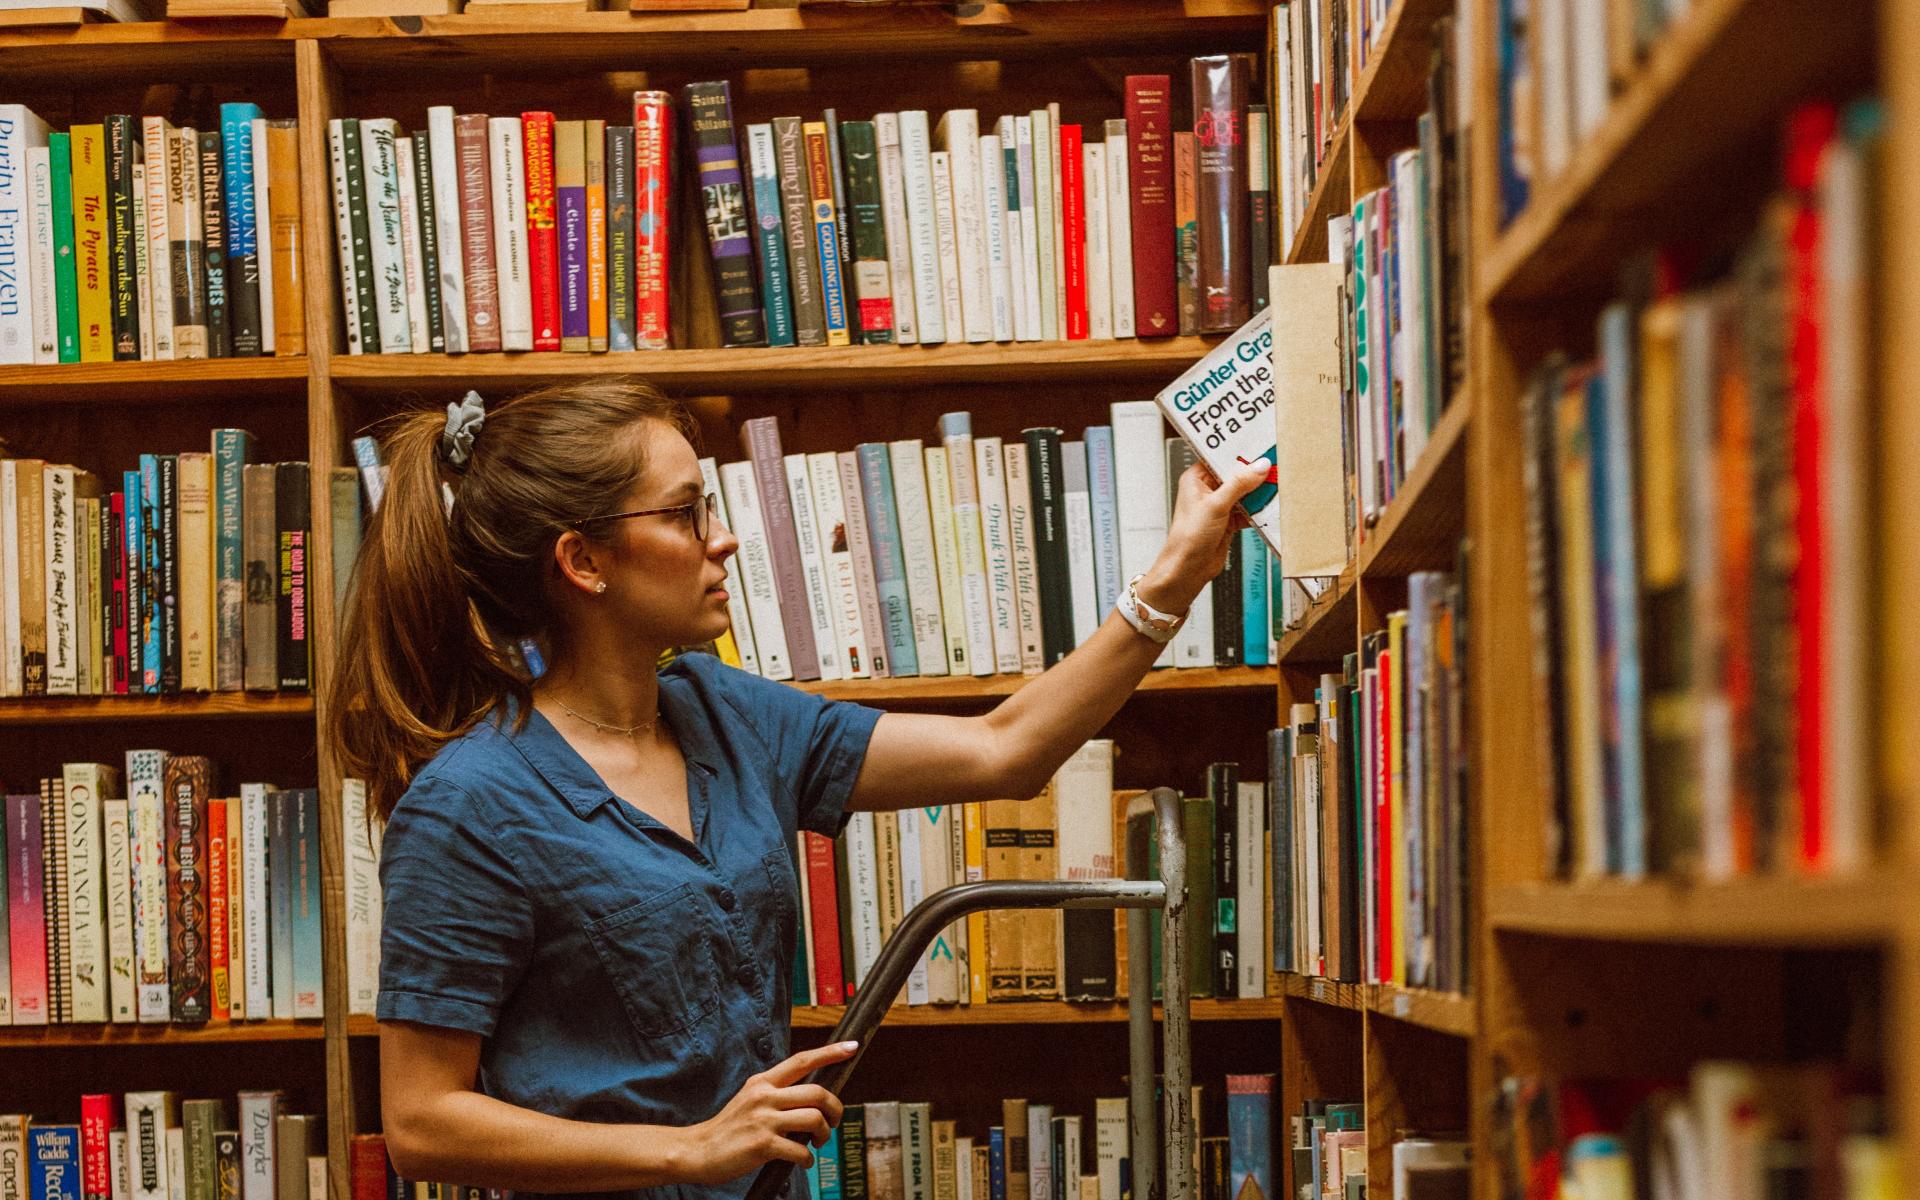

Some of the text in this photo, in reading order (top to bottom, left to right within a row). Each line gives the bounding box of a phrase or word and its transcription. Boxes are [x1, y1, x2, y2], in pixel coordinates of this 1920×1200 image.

[691, 95, 726, 107] Saints
[84, 137, 92, 164] Fraser
[111, 121, 122, 180] Michael Frayn
[144, 124, 163, 190] MICHAEL
[170, 138, 183, 204] ENTROPY
[182, 138, 196, 202] AGAINST
[526, 120, 539, 195] CHROMOSOME
[542, 143, 551, 195] CALCUTTA
[615, 135, 624, 199] AMITAV GHOSH
[35, 163, 48, 246] Caro Fraser
[151, 194, 166, 240] FRAYN
[203, 152, 221, 248] MICHAEL FRAYN
[225, 122, 240, 252] CHARLES FRAZIER
[239, 121, 258, 284] COLD MOUNTAIN
[371, 129, 396, 246] Elbowing the Seducer
[417, 136, 433, 251] EXTRAORDINARY PEOPLE
[777, 121, 807, 249] Storming Heaven
[82, 195, 100, 290] The Pyrates
[115, 192, 131, 316] A Landing on the Sun
[134, 197, 146, 275] THE TIN MEN
[346, 132, 372, 345] SYLVIE GERMAIN
[591, 208, 603, 300] Shadow Lines
[841, 237, 850, 262] Moon
[988, 187, 1001, 261] ELLEN FOSTER
[0, 208, 20, 316] Franzen
[209, 268, 224, 305] SPIES
[567, 209, 580, 311] Circle Reason
[614, 232, 626, 320] THE HUNGRY TIDE
[795, 256, 810, 304] GIARDINA
[820, 224, 844, 327] GOOD KING HARRY
[1173, 358, 1237, 412] Günter
[1187, 366, 1270, 433] From the
[984, 445, 994, 477] Gilchrist
[1009, 447, 1020, 479] Gilchrist
[1205, 417, 1241, 449] of a
[218, 434, 240, 538] Rip Van Winkle
[1039, 439, 1052, 500] ELLEN GILCHRIST
[1096, 439, 1109, 496] GILCHRIST
[163, 461, 172, 592] Columbus Slaughters Braves
[280, 531, 291, 550] FRITZ
[291, 531, 304, 546] THE
[866, 449, 882, 498] Victory
[878, 540, 894, 578] Japan
[291, 549, 304, 571] ROAD
[292, 574, 304, 585] TO
[990, 504, 1012, 630] Drunk With Love
[1012, 505, 1037, 632] Drunk With Love
[1102, 518, 1115, 585] DANGEROUS
[128, 516, 138, 672] COLUMBUS SLAUGHTERS BRAVES
[281, 577, 292, 595] FRIES
[837, 561, 857, 637] RHODA
[966, 573, 983, 644] Ellen Gilchrist
[1106, 587, 1115, 607] AGE
[887, 595, 904, 649] Gilchrist
[915, 607, 926, 643] Gilchrist
[927, 613, 938, 635] Ellen
[70, 784, 90, 931] CONSTANCIA
[178, 784, 194, 883] DESTINY DESIRE
[230, 837, 238, 850] THE
[230, 852, 238, 867] OLD
[1093, 854, 1114, 869] ONE
[110, 820, 126, 930] CONSTANCIA
[210, 837, 225, 959] CARLOS FUENTES
[352, 853, 376, 925] Loving
[1068, 867, 1115, 880] MILLION
[145, 874, 158, 965] CARLOS FUENTES
[183, 893, 196, 974] CARLOS FUENTES
[231, 902, 240, 960] CARLOS FUENTES
[216, 972, 227, 1005] USED
[36, 1131, 70, 1146] William
[38, 1145, 69, 1160] Gaddis
[85, 1118, 95, 1146] ARE
[95, 1117, 106, 1188] JUST WHEN
[117, 1138, 125, 1163] Peter
[140, 1116, 156, 1186] METROPOLIS
[843, 1121, 863, 1138] THE
[909, 1112, 921, 1186] YEARS FROM
